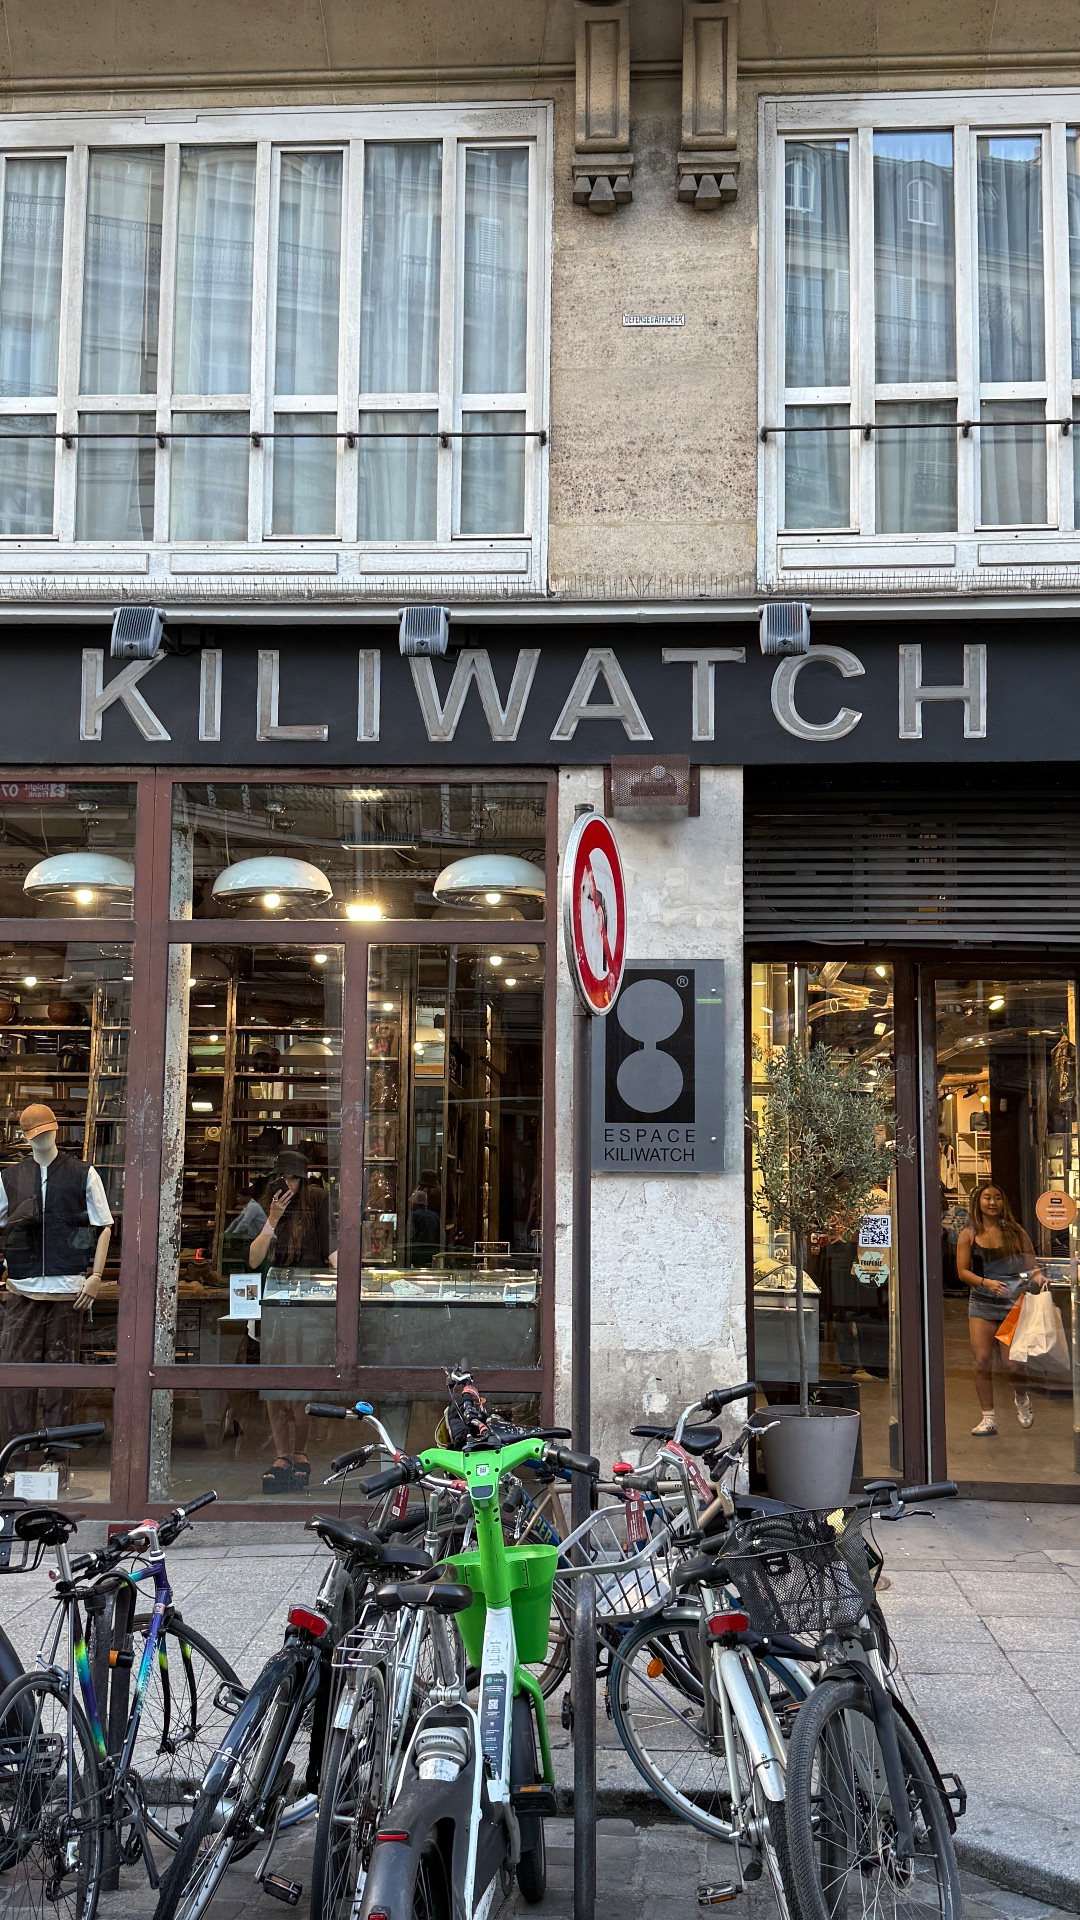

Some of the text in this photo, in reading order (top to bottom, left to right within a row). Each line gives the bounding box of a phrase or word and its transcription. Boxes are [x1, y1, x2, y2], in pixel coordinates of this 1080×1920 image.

[79, 644, 987, 742] KILIWATCH
[604, 1129, 696, 1143] ESPACE
[604, 1147, 695, 1162] KILIWATCH
